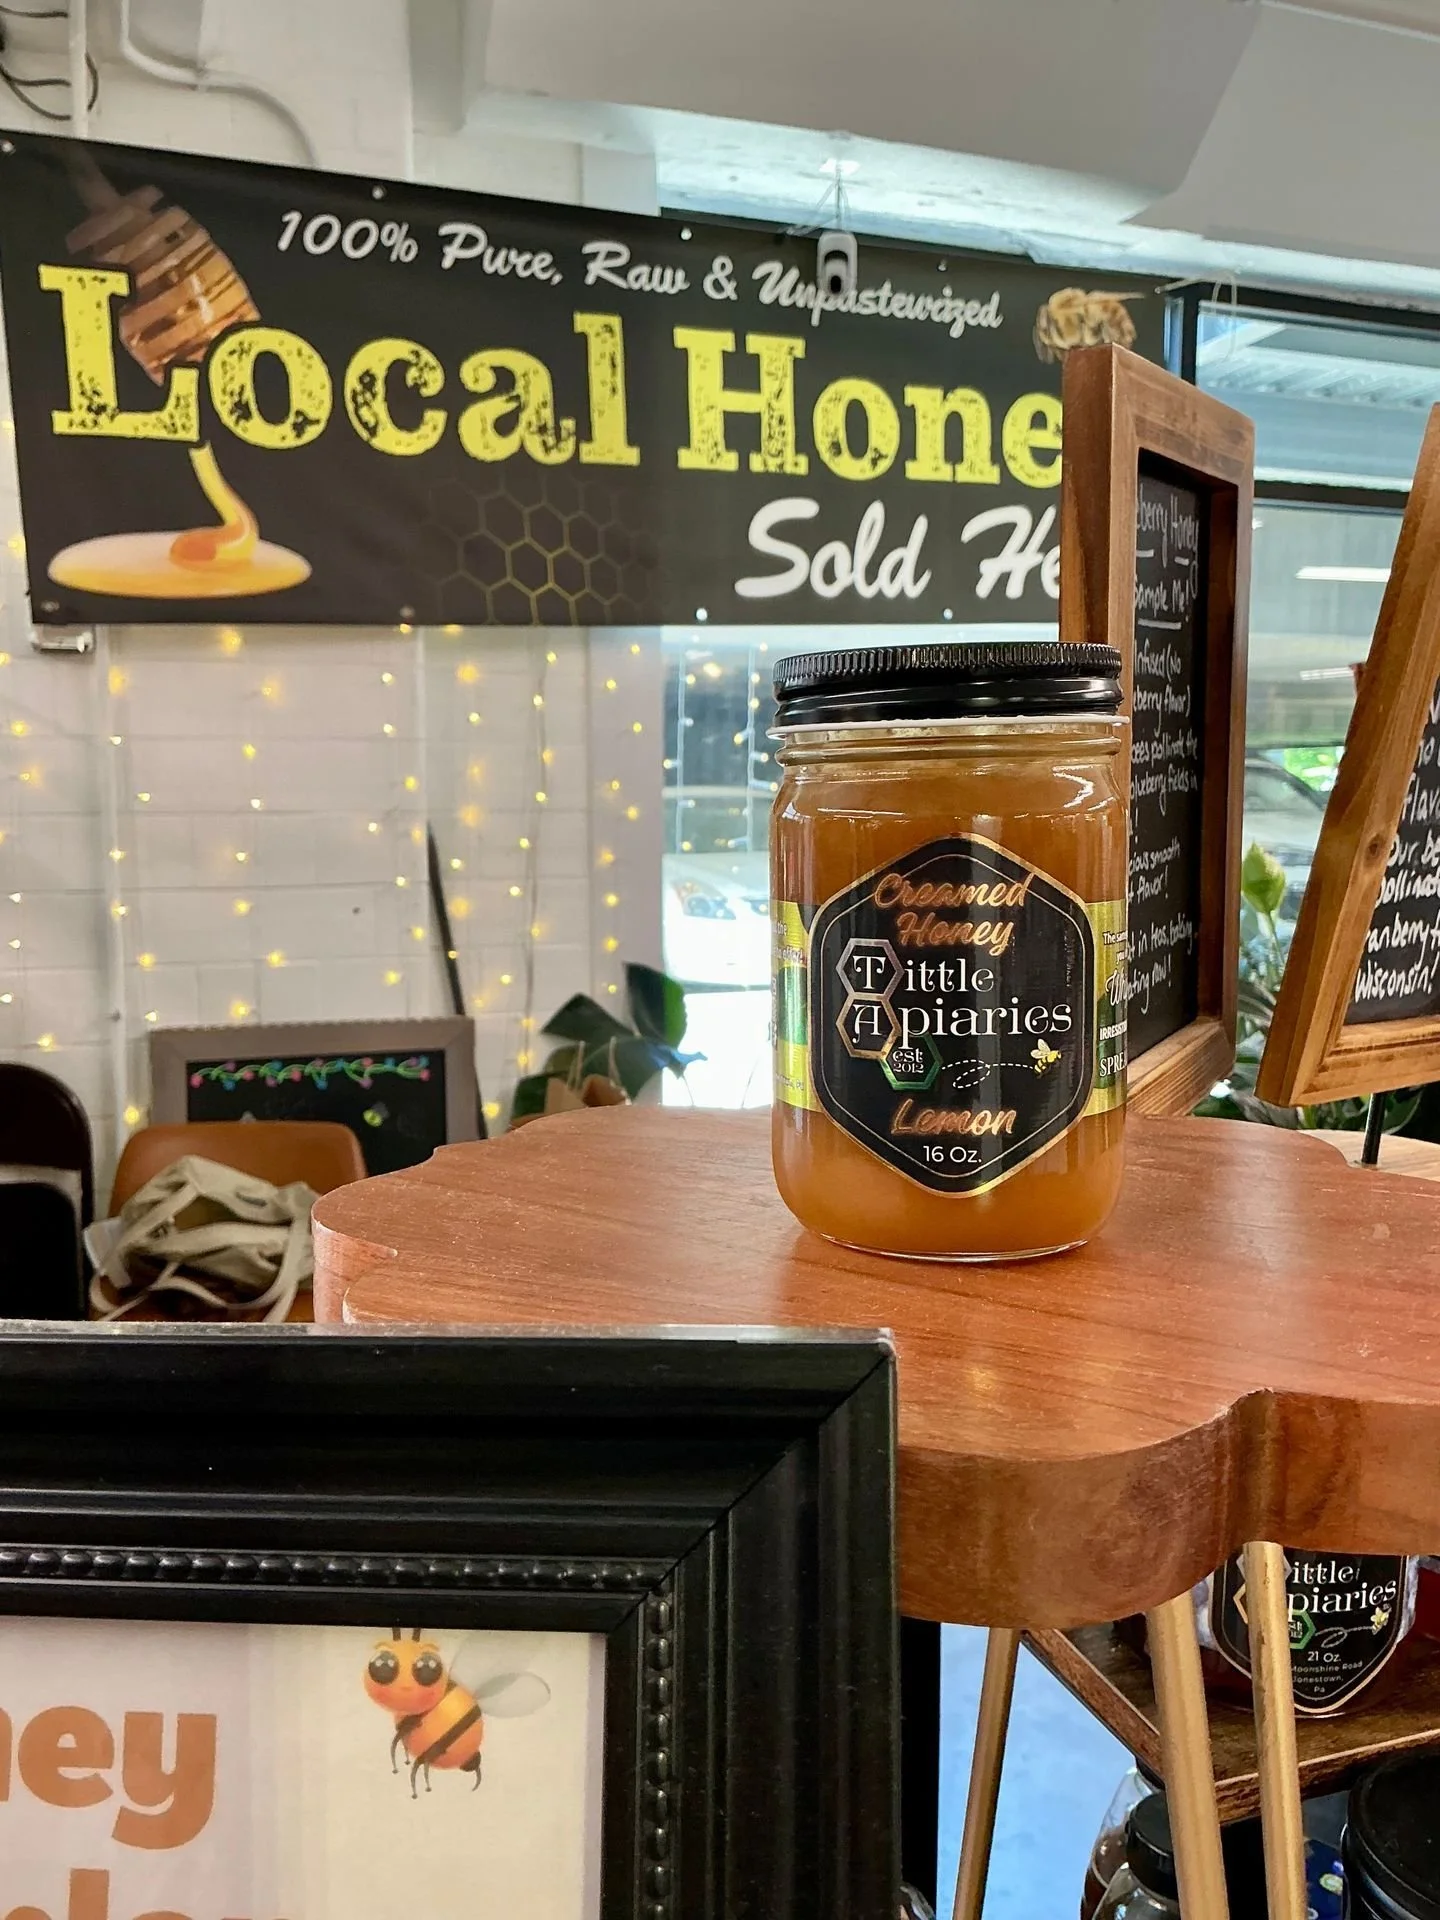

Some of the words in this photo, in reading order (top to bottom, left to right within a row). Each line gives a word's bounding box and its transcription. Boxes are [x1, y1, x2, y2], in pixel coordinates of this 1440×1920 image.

[278, 210, 419, 264] 100%
[438, 221, 564, 287] Pure,
[581, 240, 690, 296] Raw
[702, 255, 738, 301] &
[752, 259, 1004, 339] Unpasteurized
[38, 263, 641, 468] Local
[1135, 483, 1168, 568] berry
[734, 497, 932, 600] Sold
[1150, 835, 1180, 868] smooth
[873, 872, 1037, 909] Creamed
[1136, 864, 1169, 905] flavor!
[895, 911, 1014, 956] Honey
[1139, 929, 1149, 957] in
[853, 996, 1073, 1050] Apiaries
[892, 1062, 924, 1074] 2012
[890, 1098, 1018, 1137] Lemon
[923, 1145, 945, 1163] 16
[949, 1146, 983, 1164] Oz.
[1307, 1650, 1319, 1662] 21
